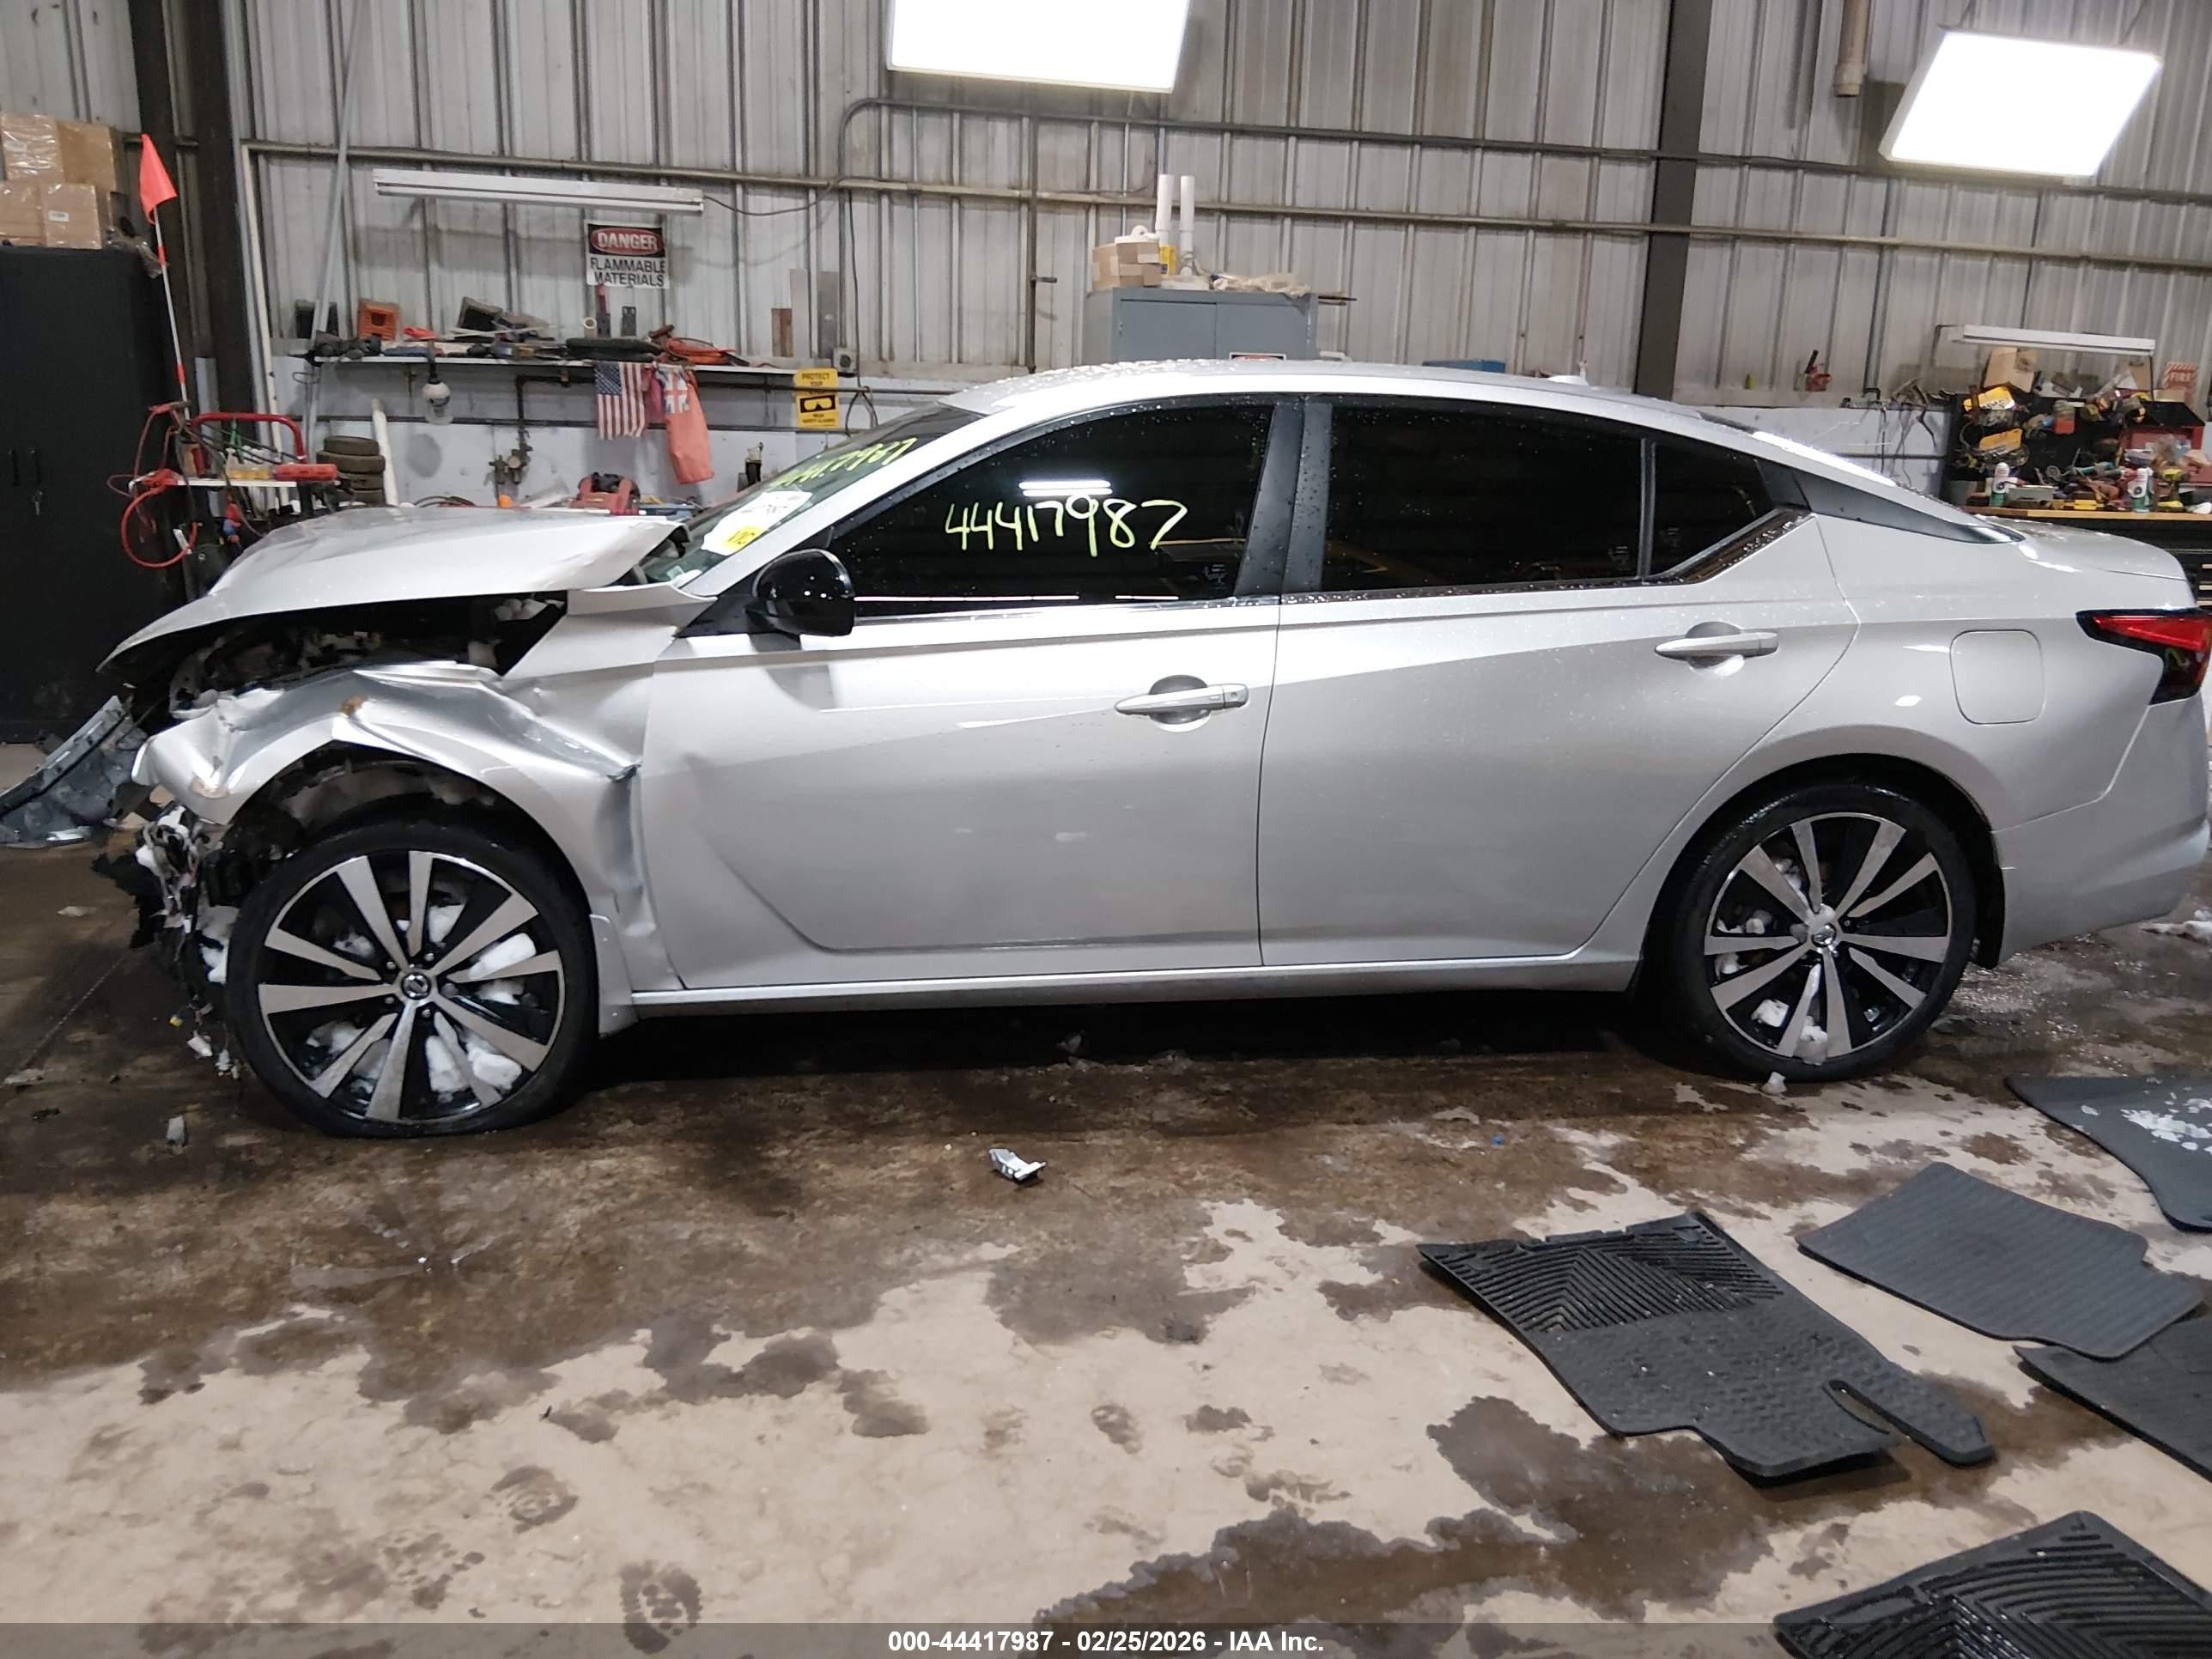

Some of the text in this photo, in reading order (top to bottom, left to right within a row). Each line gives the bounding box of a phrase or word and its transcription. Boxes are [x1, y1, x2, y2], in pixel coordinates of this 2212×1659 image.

[597, 232, 659, 251] DANGER
[590, 258, 666, 274] FLAMMABLE
[594, 272, 665, 288] MATERIALS
[945, 495, 1188, 557] 44417987
